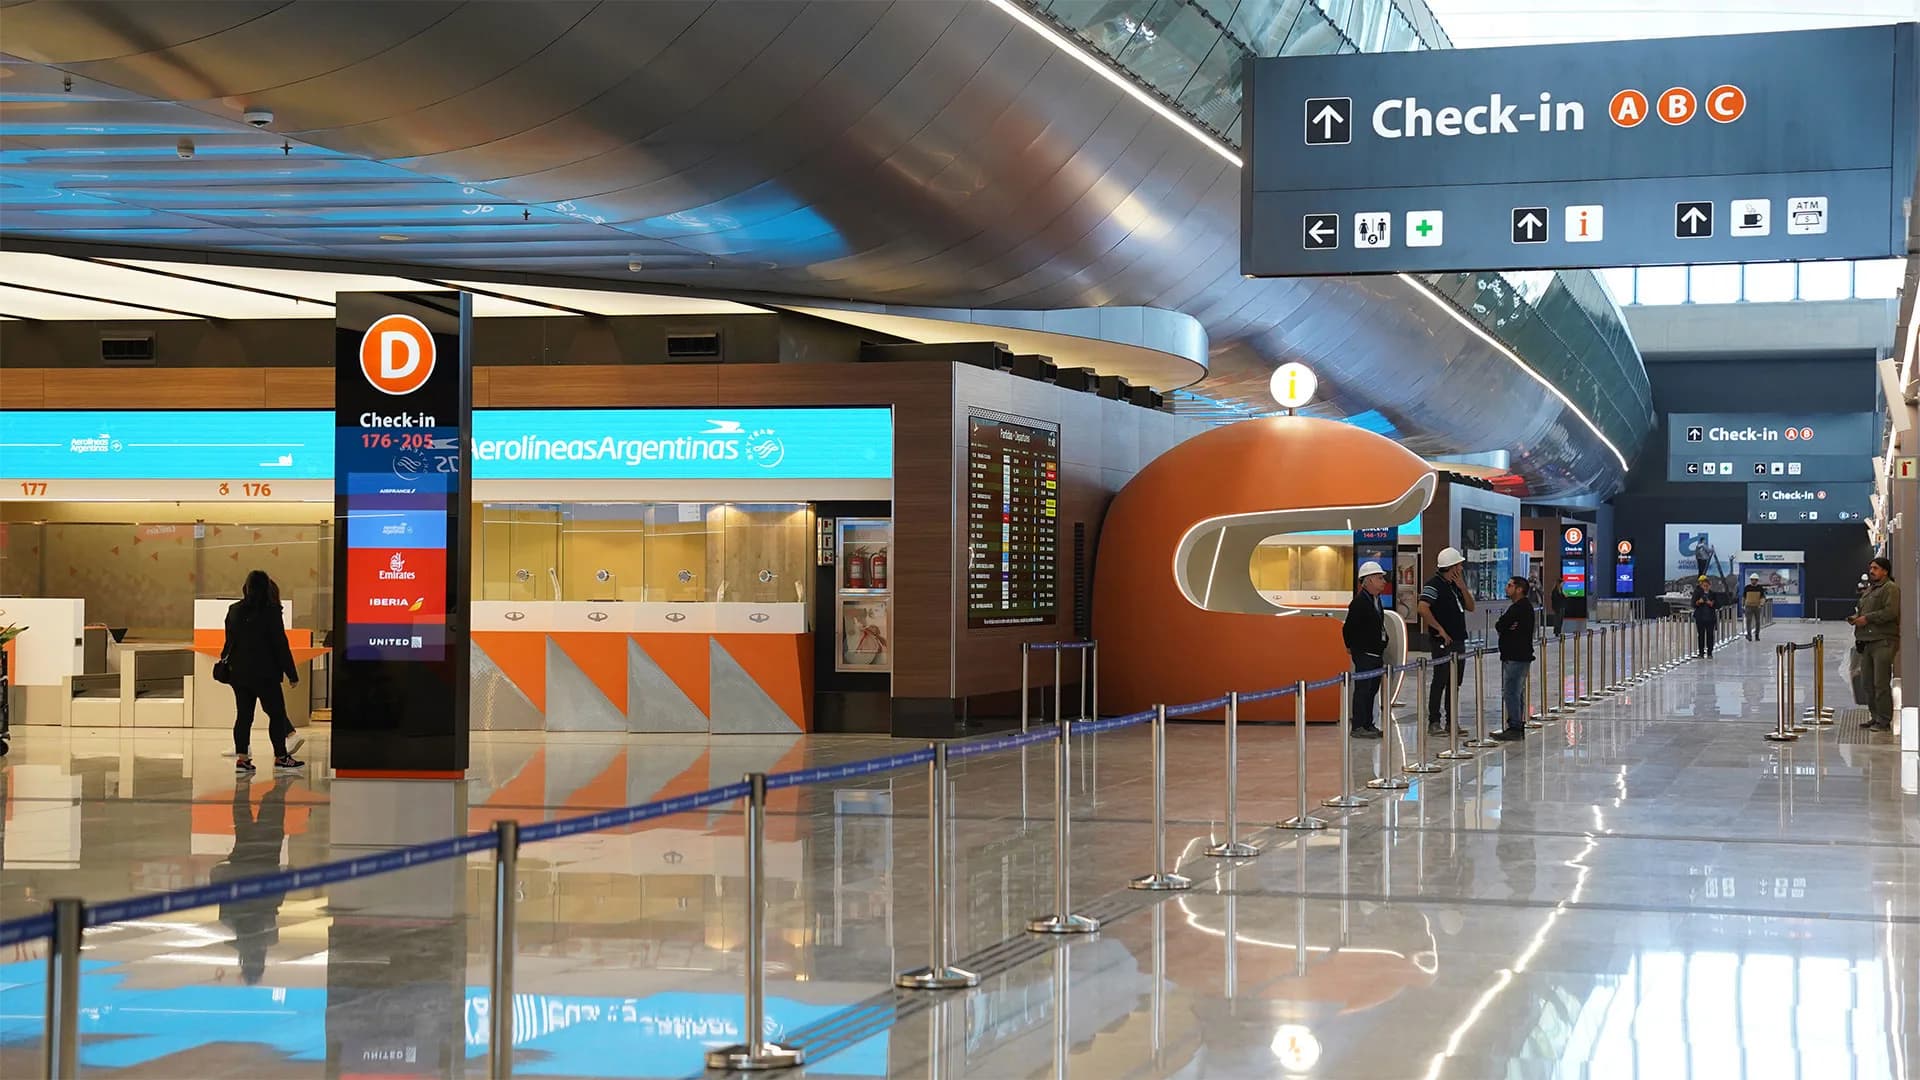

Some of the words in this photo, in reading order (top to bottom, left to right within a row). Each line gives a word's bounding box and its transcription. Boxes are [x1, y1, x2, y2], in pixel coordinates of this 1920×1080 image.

[1371, 92, 1585, 139] Check-in
[1617, 97, 1639, 120] A
[1667, 95, 1687, 118] B
[1715, 92, 1735, 116] C
[1796, 201, 1819, 209] ATM
[380, 331, 420, 379] D
[359, 412, 436, 428] Check-in
[1709, 427, 1778, 441] Check-in
[21, 483, 47, 496] 177
[243, 483, 271, 497] 176
[1772, 490, 1814, 500] Check-in
[379, 569, 415, 580] Emirates
[369, 598, 409, 606] IBERIA
[369, 637, 410, 646] UNITED
